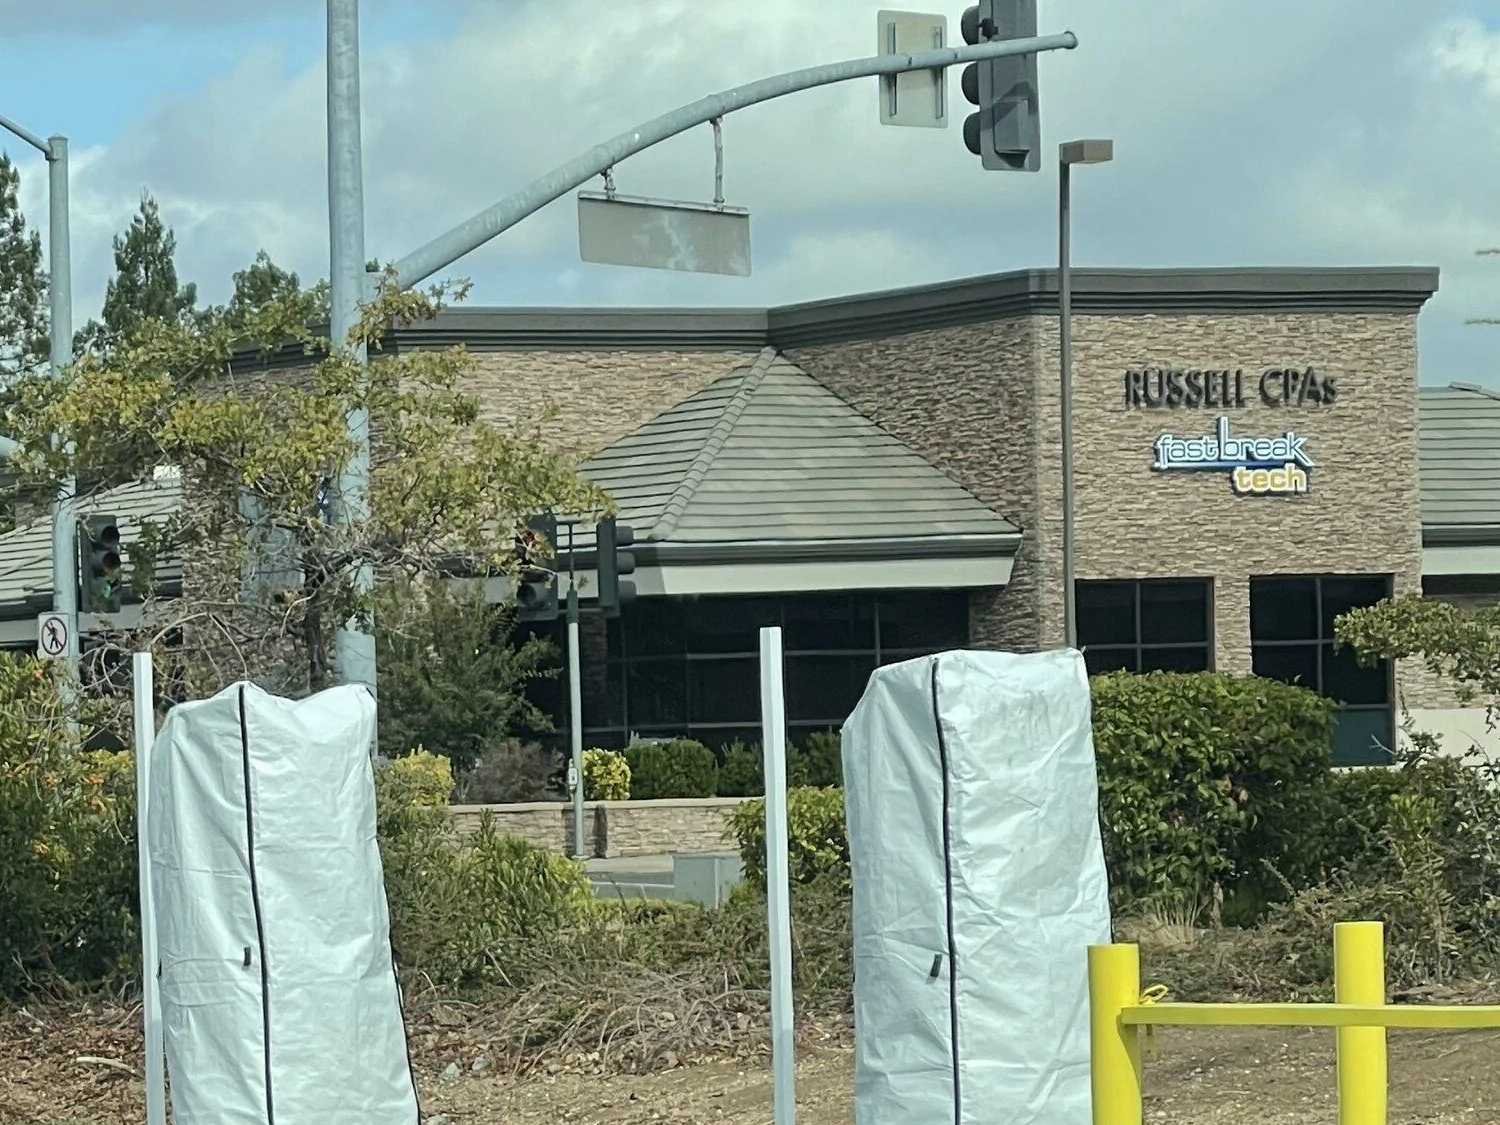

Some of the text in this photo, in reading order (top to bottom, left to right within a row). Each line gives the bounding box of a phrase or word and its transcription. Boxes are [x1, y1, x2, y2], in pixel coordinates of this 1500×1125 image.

[1125, 366, 1338, 408] RUSSELL CPAs
[1233, 464, 1307, 493] tech
